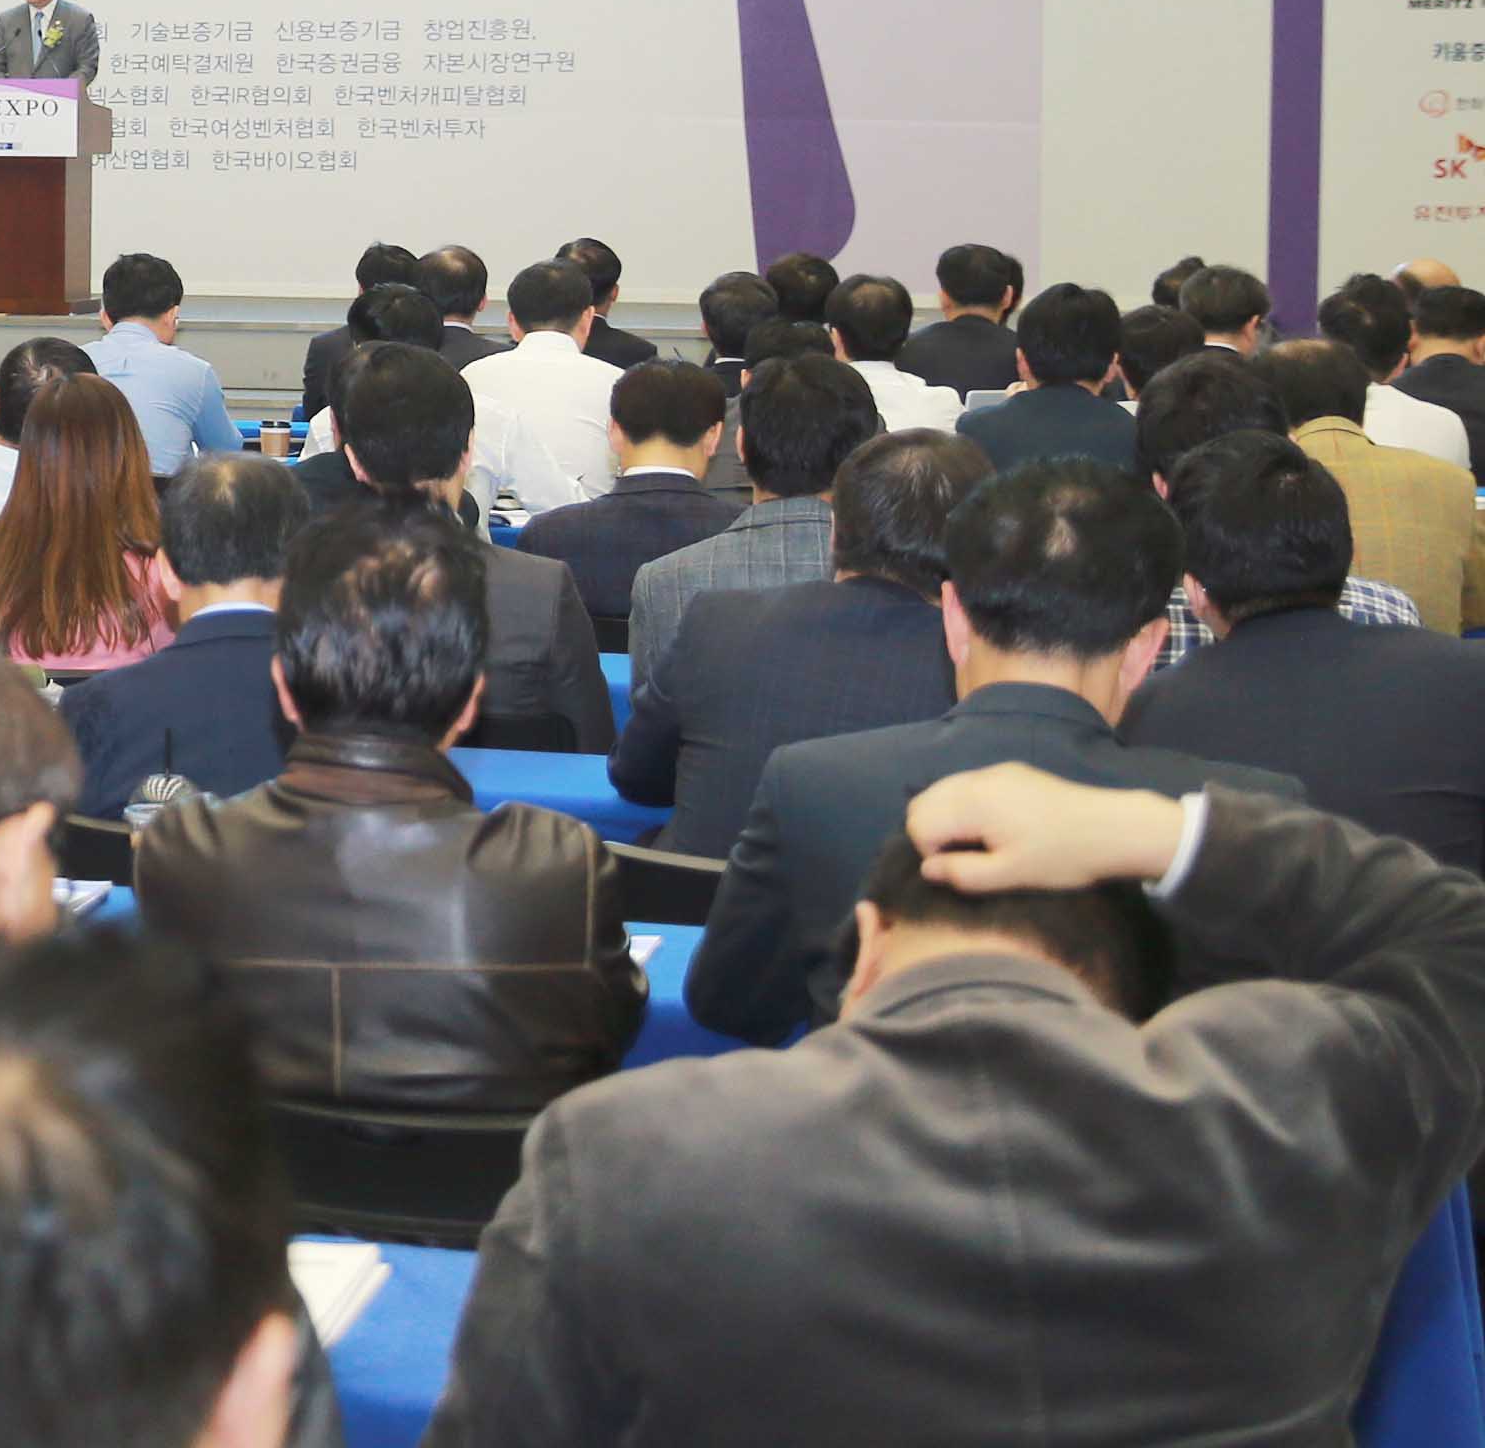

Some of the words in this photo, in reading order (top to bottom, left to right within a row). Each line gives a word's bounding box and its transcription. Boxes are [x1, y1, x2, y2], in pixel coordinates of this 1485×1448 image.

[132, 21, 253, 42] 기술보증기금
[276, 20, 401, 42] 신용보증기금
[111, 54, 253, 74] 한국예탁결제원
[277, 53, 402, 74] 한국증권금융
[424, 52, 574, 74] 자본시장연구원
[192, 86, 311, 106] 한국IR협의회
[335, 85, 525, 106] 한국벤처캐피탈협회
[169, 117, 334, 139] 한국여성벤처협회
[358, 117, 485, 139] 한국벤처투자
[213, 150, 356, 171] 한국바이오협회
[1435, 160, 1465, 178] SK
